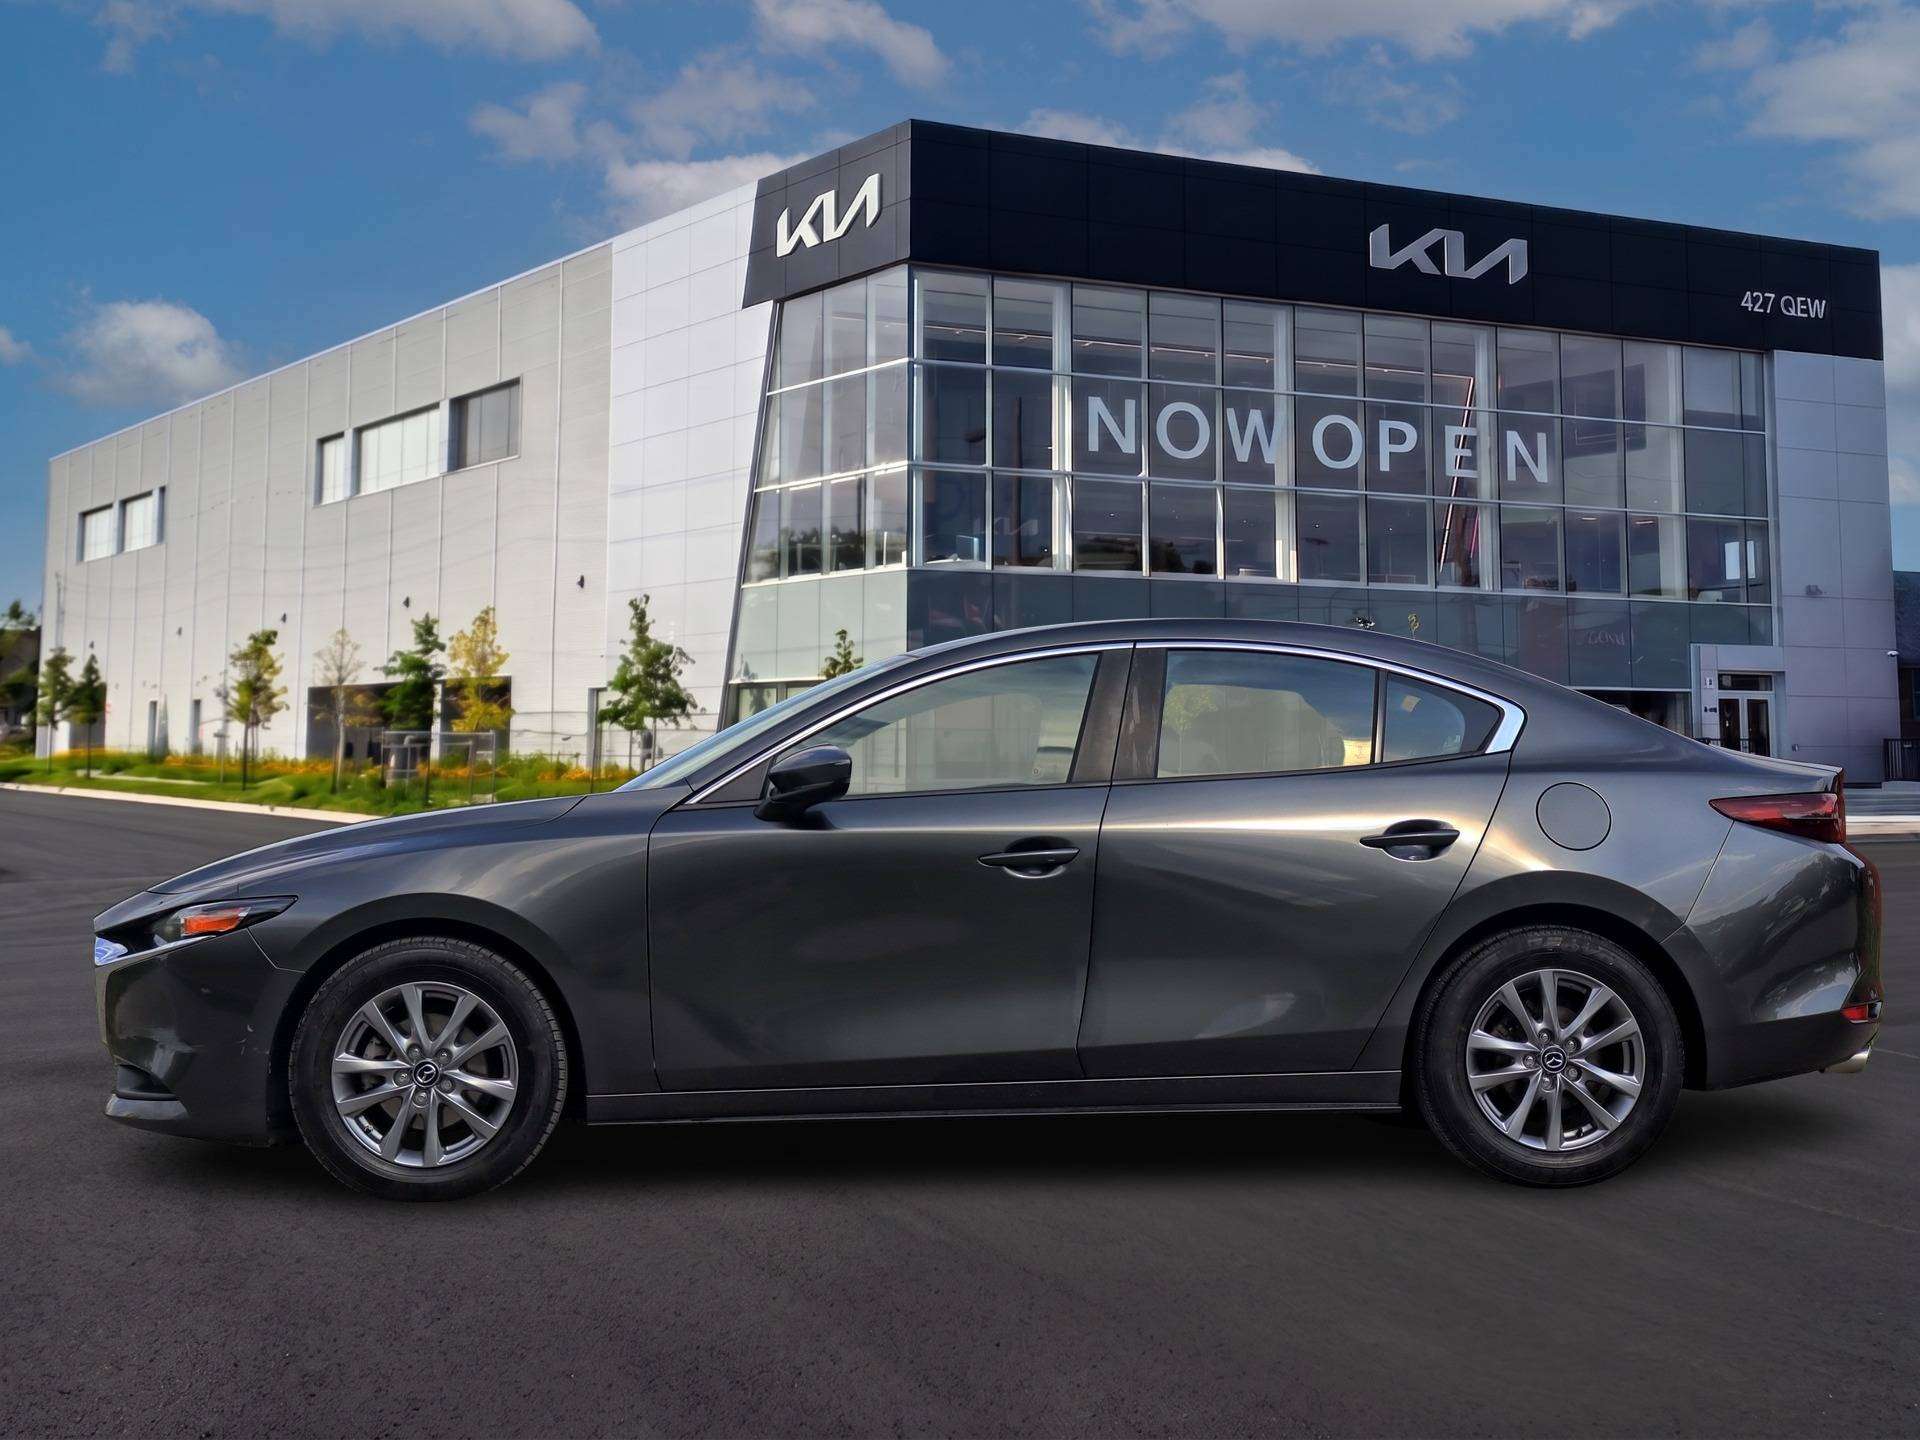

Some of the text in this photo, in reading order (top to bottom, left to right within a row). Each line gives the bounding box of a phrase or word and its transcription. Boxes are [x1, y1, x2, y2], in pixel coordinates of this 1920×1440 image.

[1741, 291, 1826, 318] 427 QEW
[1088, 396, 1548, 483] NOW OPEN
